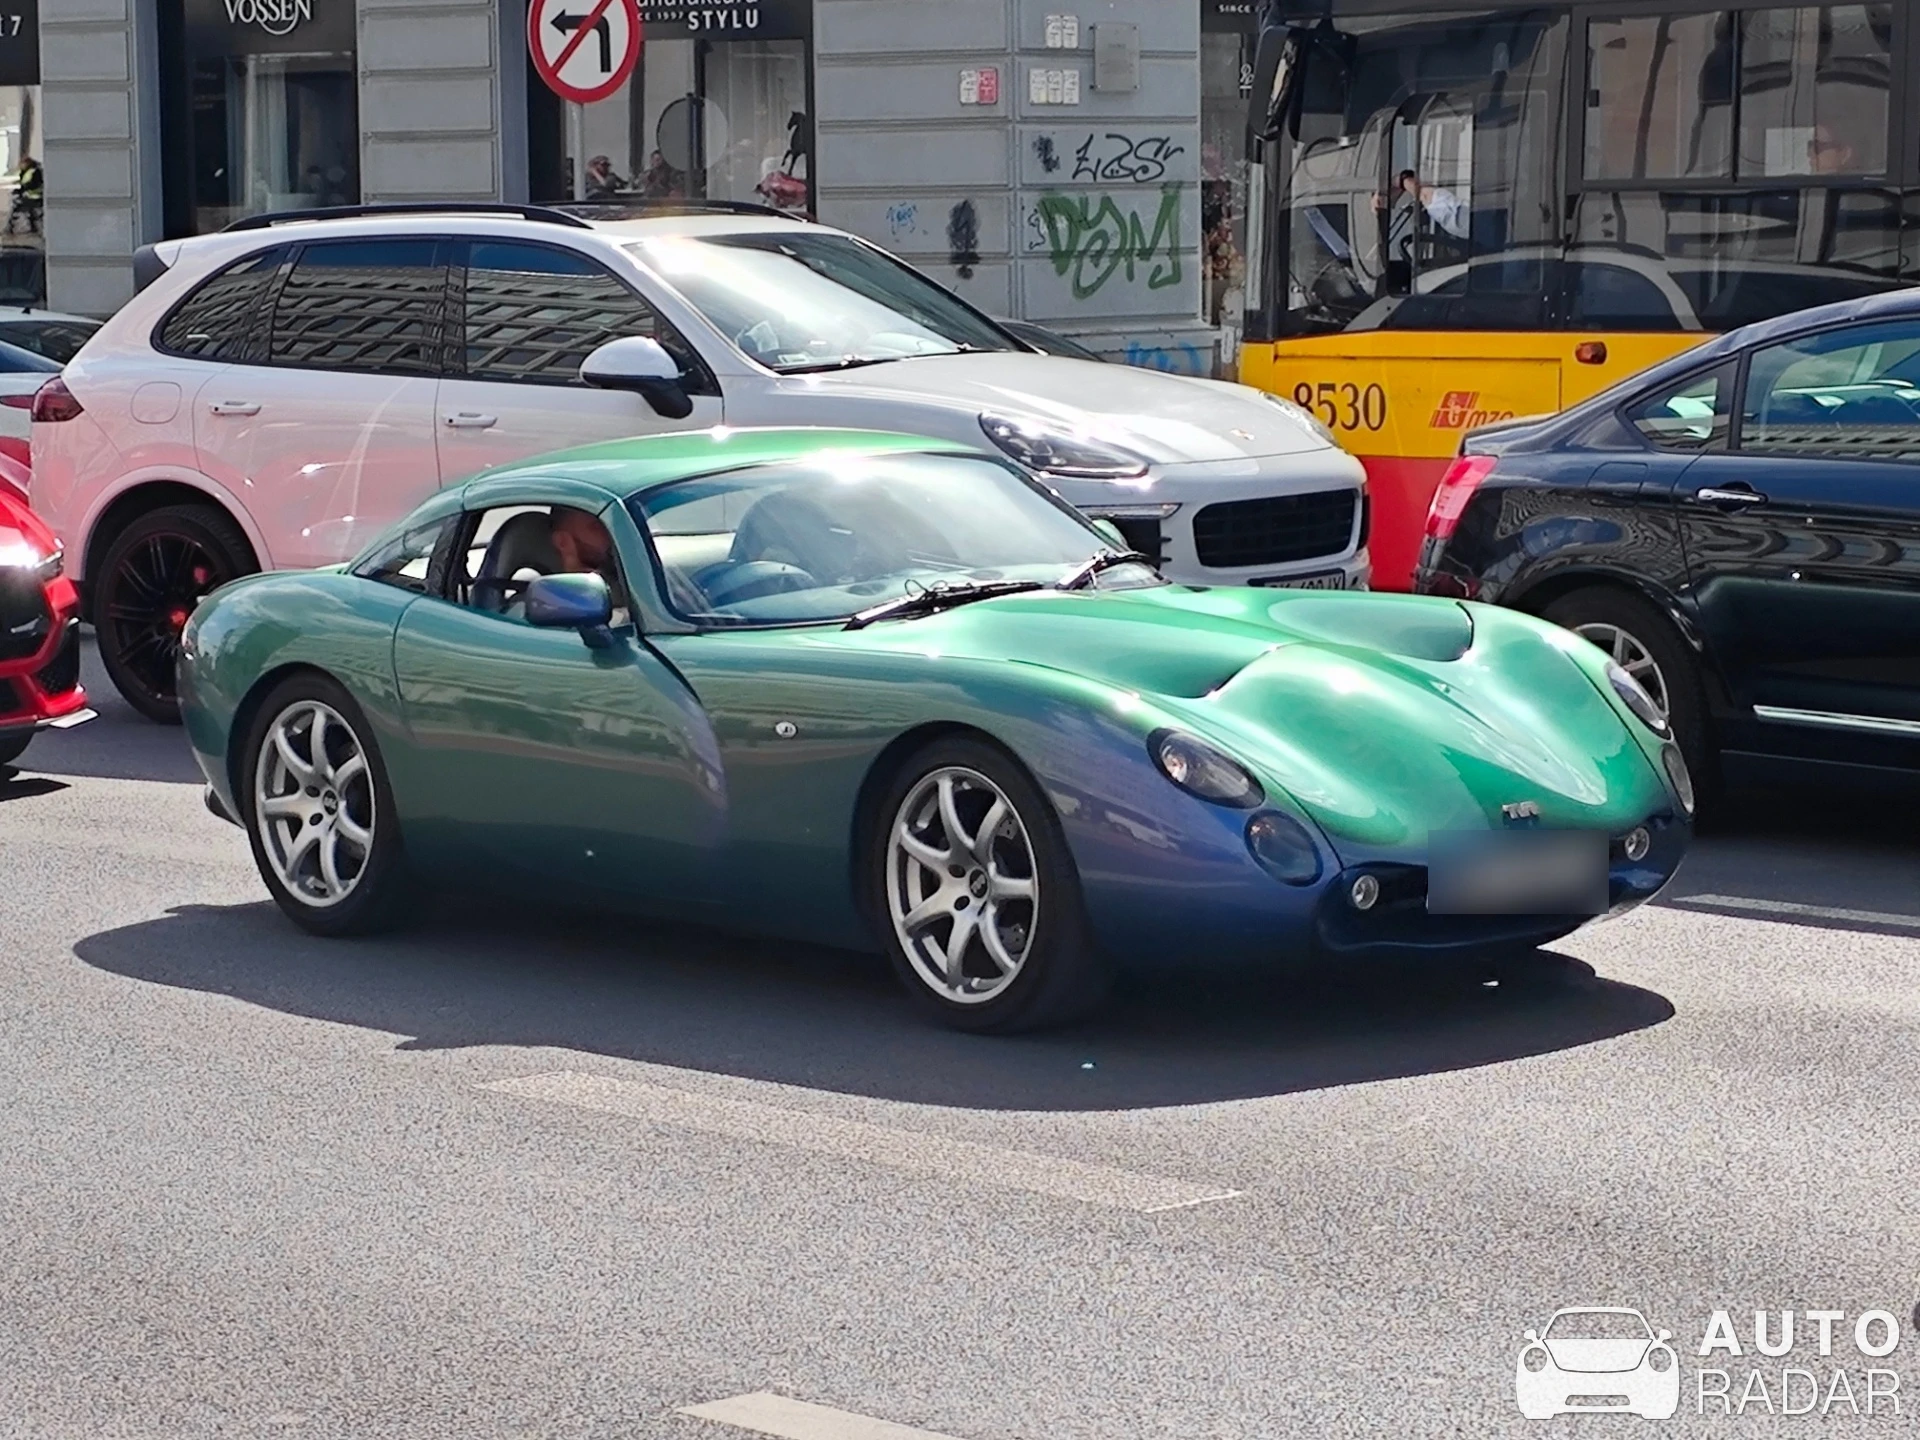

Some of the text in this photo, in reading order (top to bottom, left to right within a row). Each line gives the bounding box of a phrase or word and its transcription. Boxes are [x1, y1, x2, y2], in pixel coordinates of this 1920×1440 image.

[223, 0, 312, 36] VOSSEN
[687, 8, 759, 31] STYLU
[1218, 4, 1251, 14] SINCE
[1293, 382, 1387, 432] 8530
